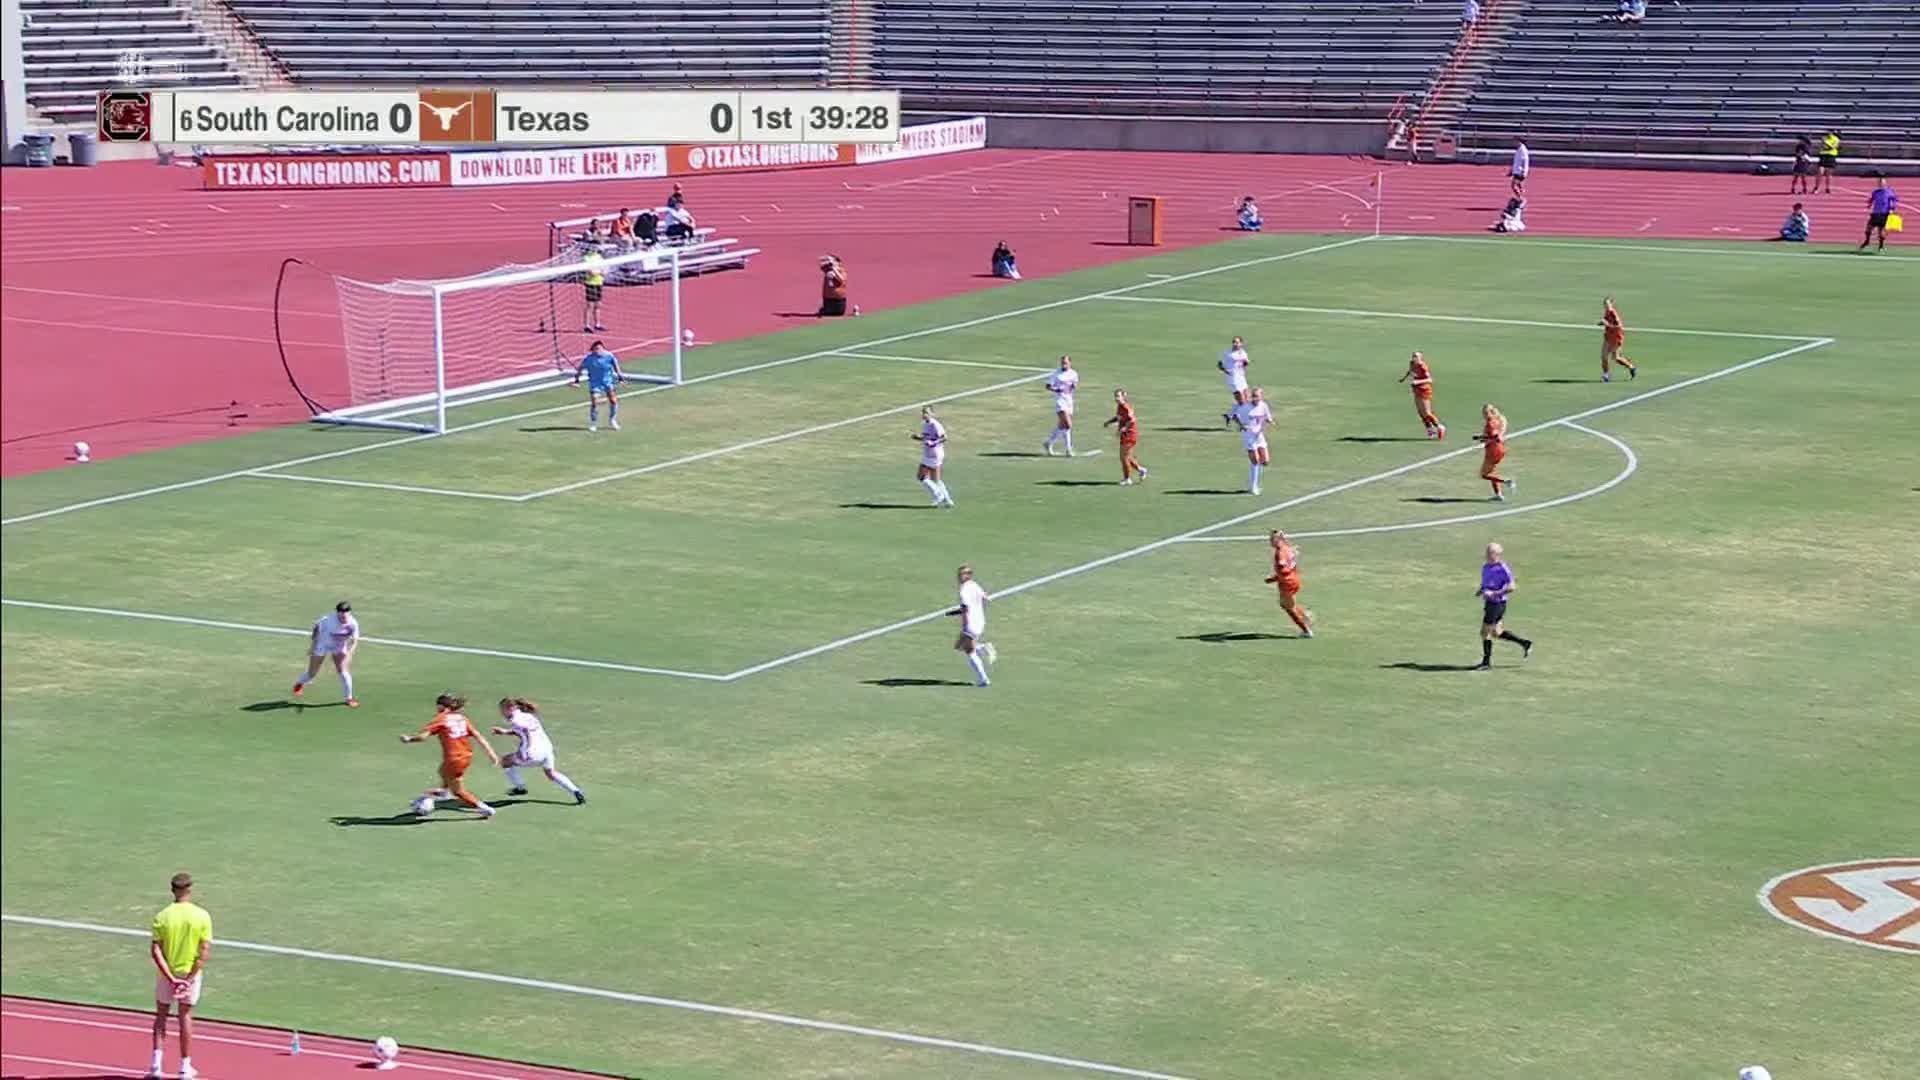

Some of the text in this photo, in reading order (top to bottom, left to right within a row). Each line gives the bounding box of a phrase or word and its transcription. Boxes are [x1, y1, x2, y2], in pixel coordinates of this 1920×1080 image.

[214, 159, 441, 186] TEXASLONGHORNS.COM
[460, 157, 543, 178] DOWNLOAD
[549, 156, 576, 174] THE
[624, 152, 657, 172] APP!
